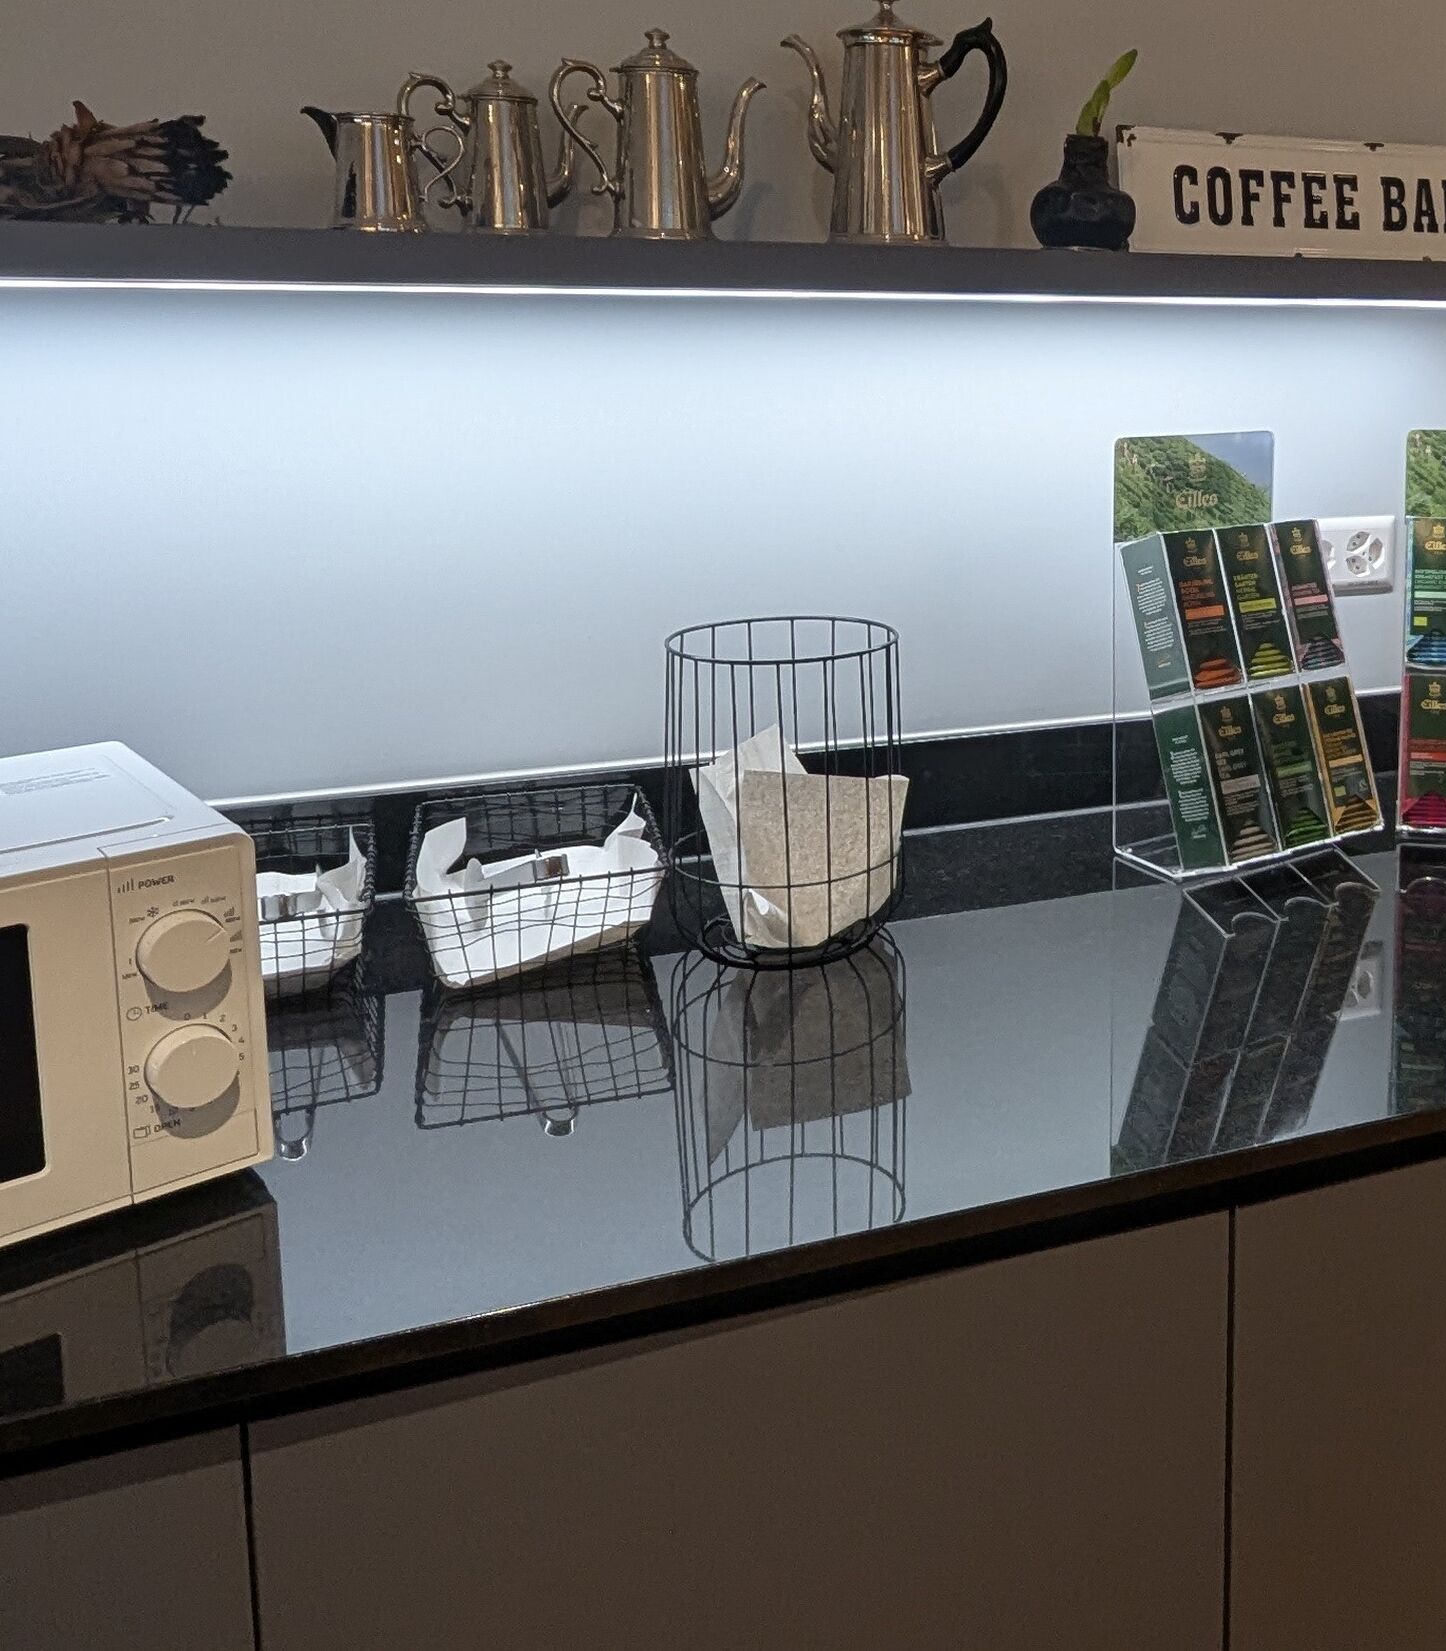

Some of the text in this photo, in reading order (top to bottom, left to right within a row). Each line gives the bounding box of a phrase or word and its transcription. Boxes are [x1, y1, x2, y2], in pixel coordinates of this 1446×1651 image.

[1173, 164, 1360, 230] COFFEE
[1176, 490, 1218, 509] Eilles
[138, 874, 176, 890] POWER
[145, 1002, 168, 1015] TIME
[219, 1014, 226, 1022] 2
[232, 1024, 238, 1032] 3
[238, 1036, 245, 1044] 4
[239, 1052, 245, 1061] 5
[128, 1065, 140, 1075] 30
[128, 1081, 140, 1090] 25
[135, 1094, 149, 1104] 20
[154, 1118, 181, 1133] OPEN
